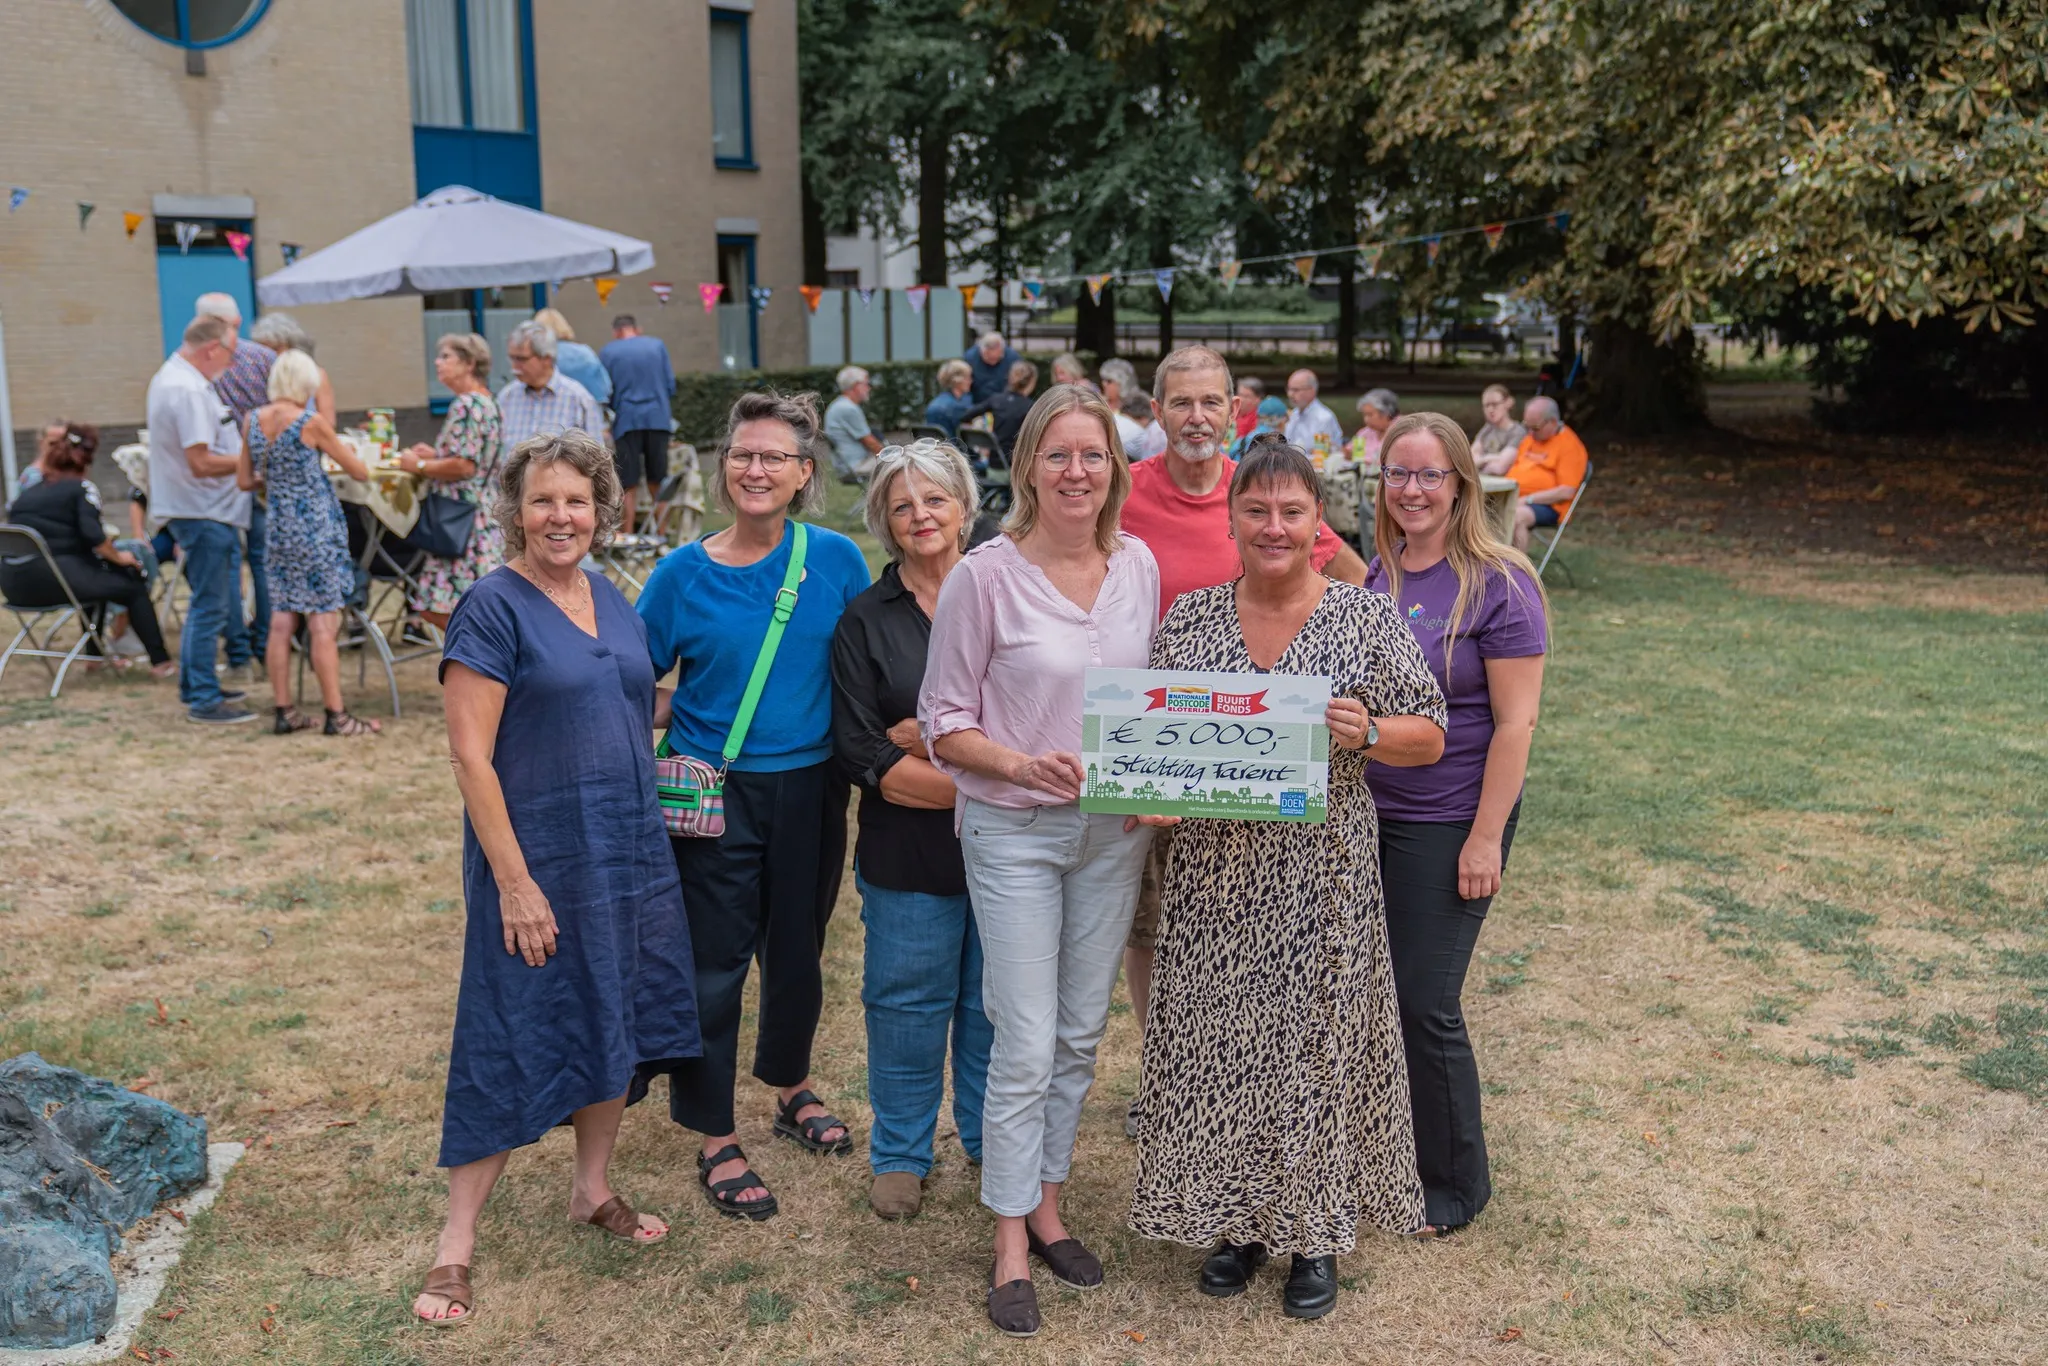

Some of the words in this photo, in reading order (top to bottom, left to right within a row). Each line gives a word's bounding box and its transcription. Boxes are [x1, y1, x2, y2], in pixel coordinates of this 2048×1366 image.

[1168, 699, 1209, 708] POSTCODE
[1217, 695, 1251, 705] BUURT
[1217, 704, 1251, 714] FONDS
[1107, 718, 1142, 743] €
[1111, 754, 1206, 790] Stichting
[1213, 760, 1297, 781] Farent
[1281, 799, 1304, 808] DOEN
